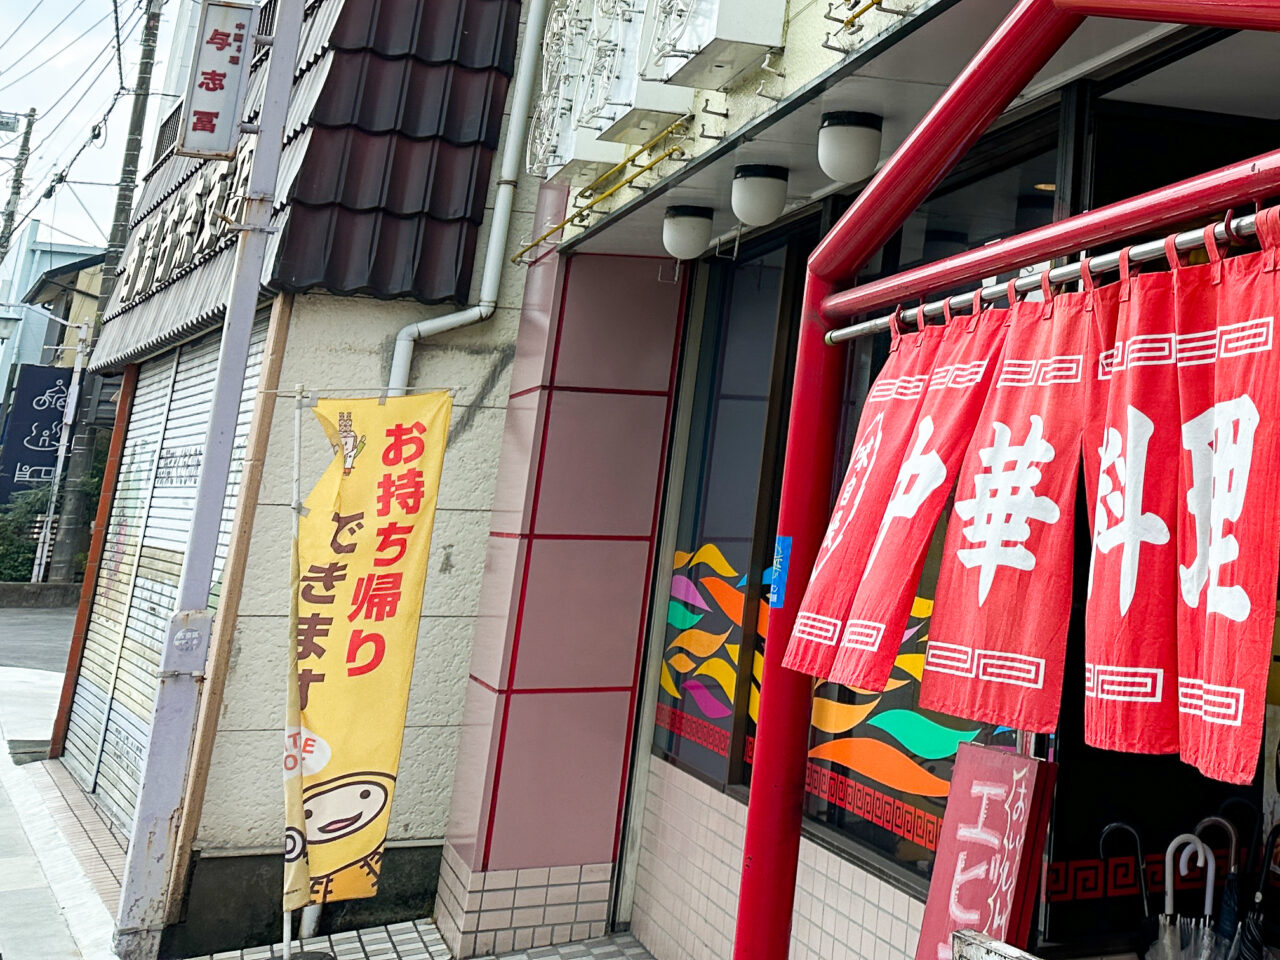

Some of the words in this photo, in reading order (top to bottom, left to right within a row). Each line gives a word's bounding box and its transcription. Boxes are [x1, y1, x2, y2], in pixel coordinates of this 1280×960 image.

[345, 420, 427, 678] お持ち帰り
[863, 393, 1260, 622] 中華料理
[936, 779, 1009, 960] エビ
